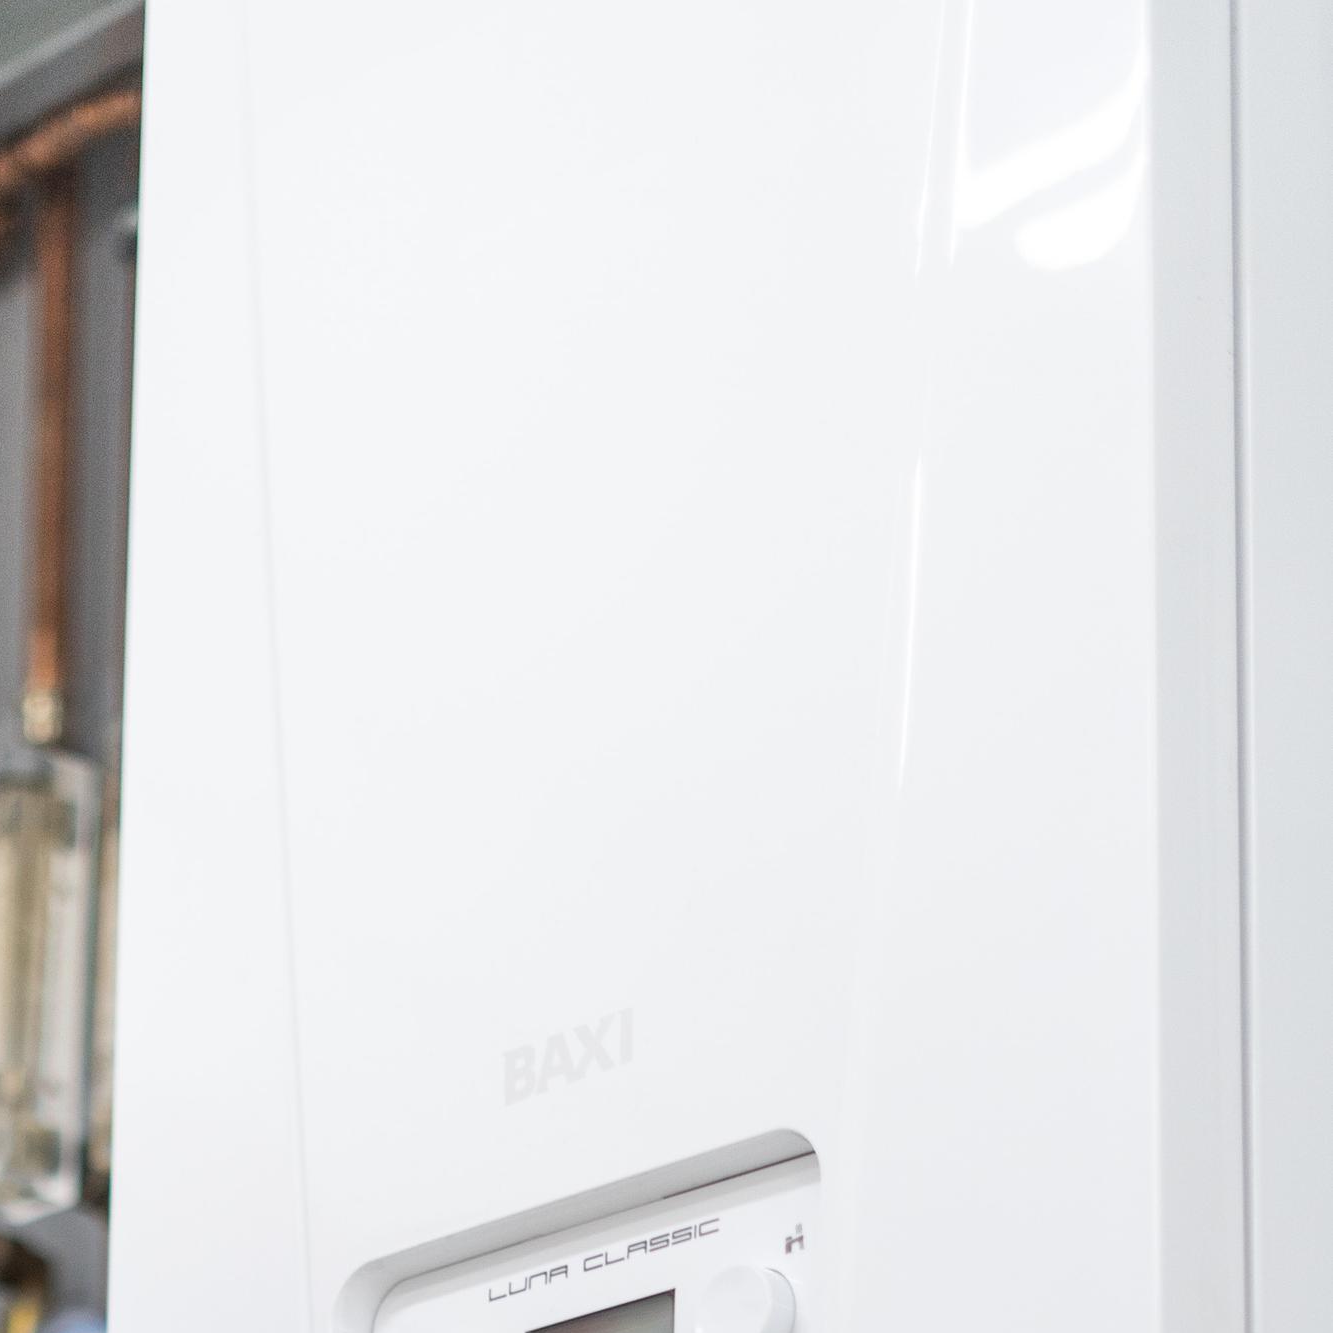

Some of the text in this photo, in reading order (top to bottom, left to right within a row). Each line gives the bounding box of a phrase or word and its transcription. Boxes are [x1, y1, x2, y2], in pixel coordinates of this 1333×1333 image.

[502, 1007, 633, 1106] BAXI
[489, 1218, 720, 1302] LUNA CLASSIC
